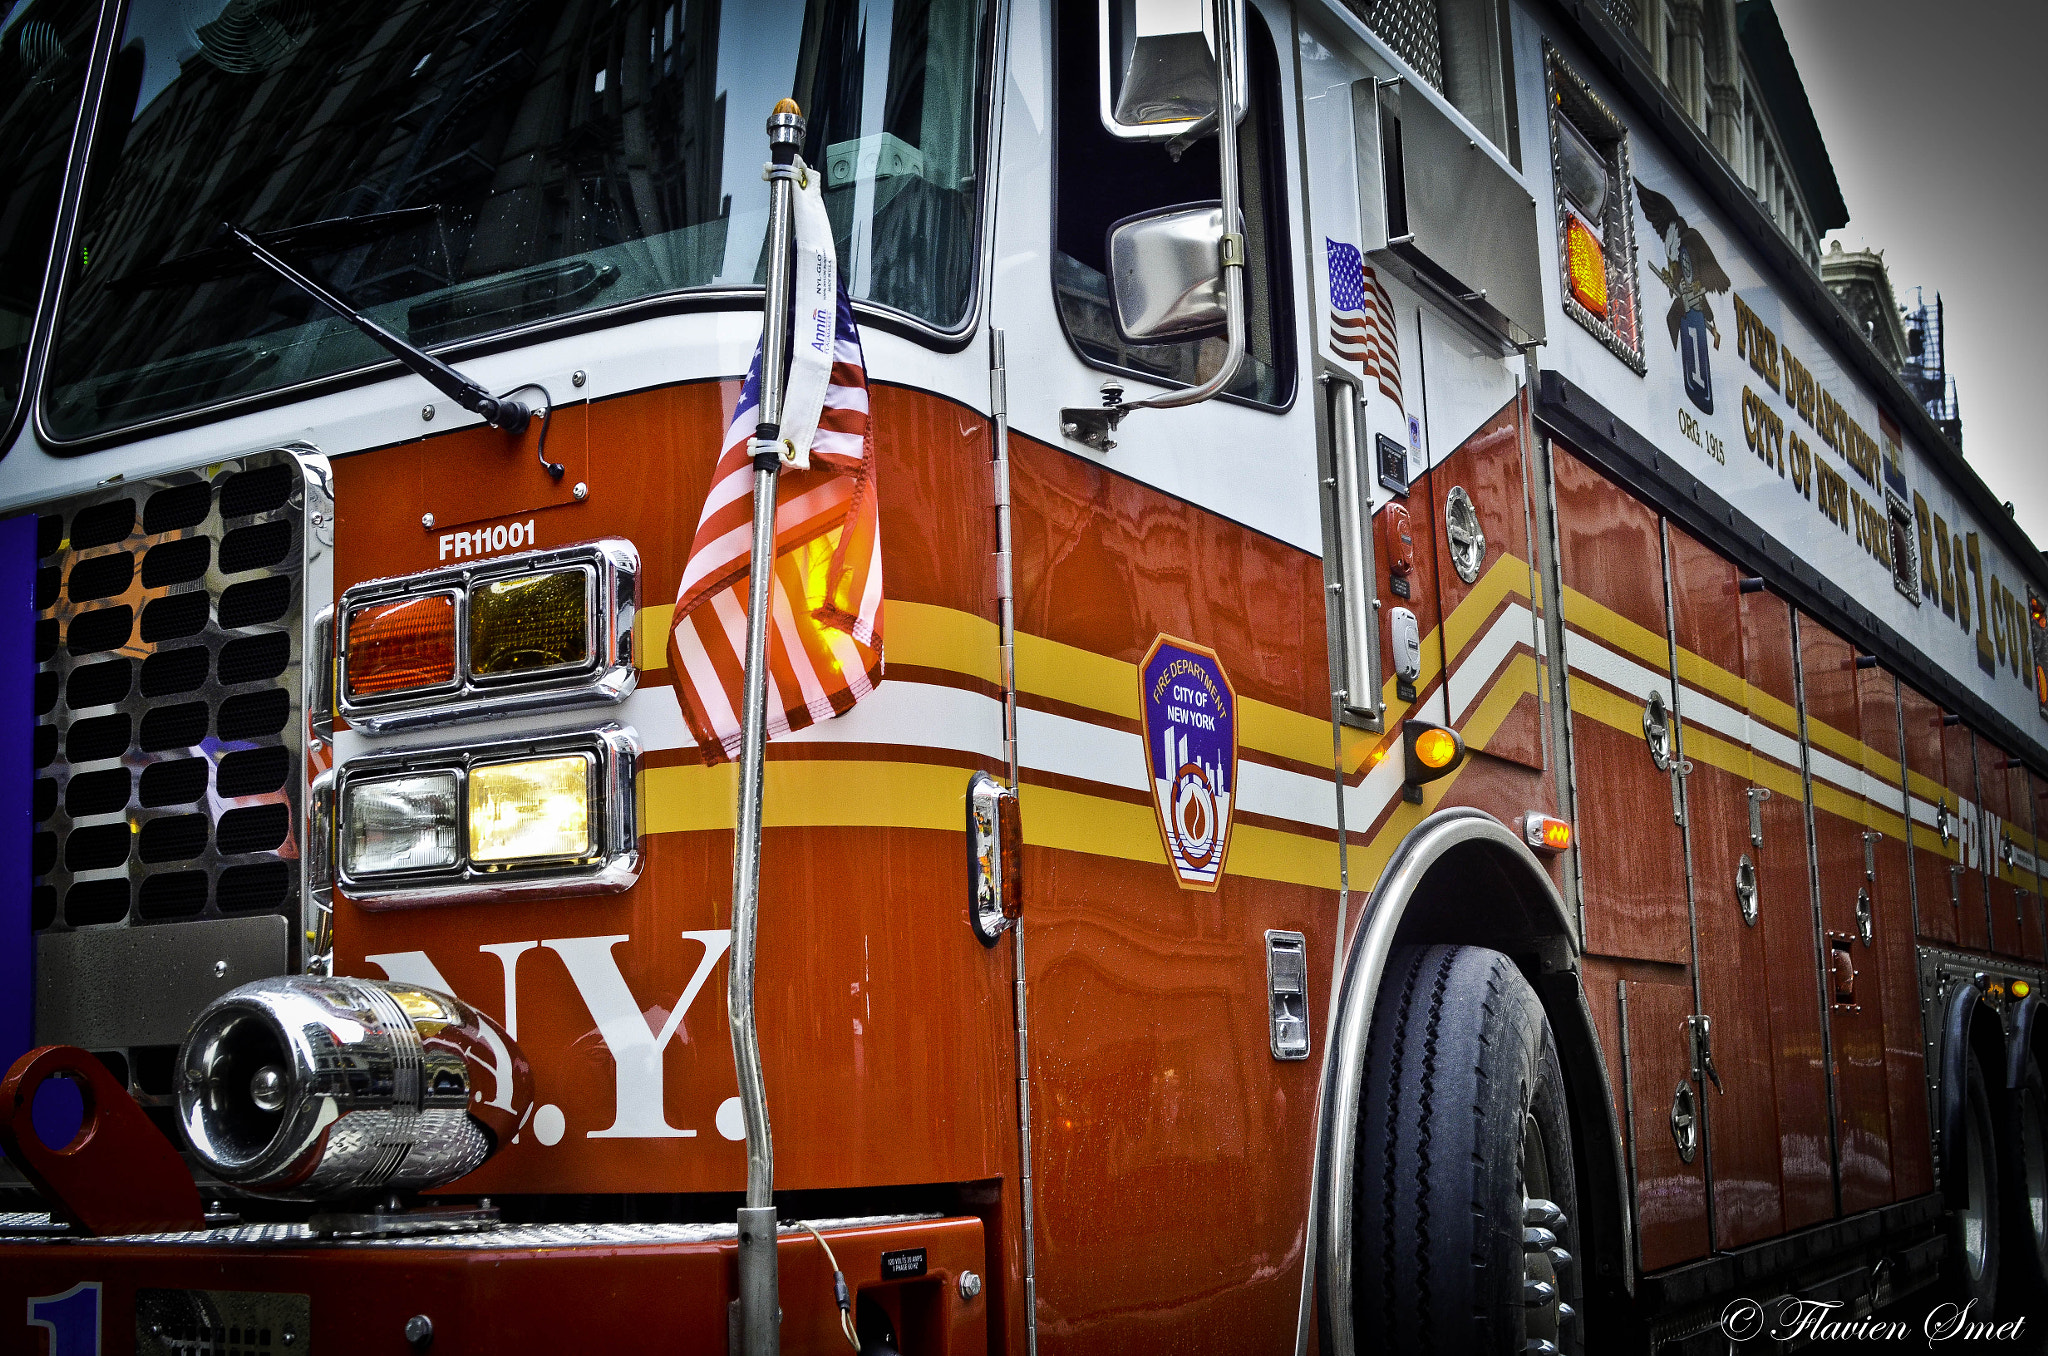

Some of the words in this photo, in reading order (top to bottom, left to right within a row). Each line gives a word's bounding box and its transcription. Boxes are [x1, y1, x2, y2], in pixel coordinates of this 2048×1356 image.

[811, 309, 827, 353] Annin
[1688, 326, 1705, 389] 1
[1733, 291, 1780, 396] FIRE
[1781, 343, 1882, 497] DEPARTMENT
[1678, 408, 1703, 448] ORG.
[1705, 430, 1725, 466] 1915
[1741, 385, 1785, 480] CITY
[1789, 430, 1811, 502] OF
[1814, 453, 1849, 536] NEW
[1850, 486, 1892, 573] YORK
[439, 519, 535, 561] FR11001
[1153, 668, 1172, 704] FIRE
[1169, 659, 1227, 719] DEPARTMENT
[1167, 705, 1189, 725] NEW
[1190, 710, 1215, 732] YORK
[1173, 685, 1194, 704] CITY
[1195, 691, 1208, 708] OF
[26, 1281, 103, 1356] 1
